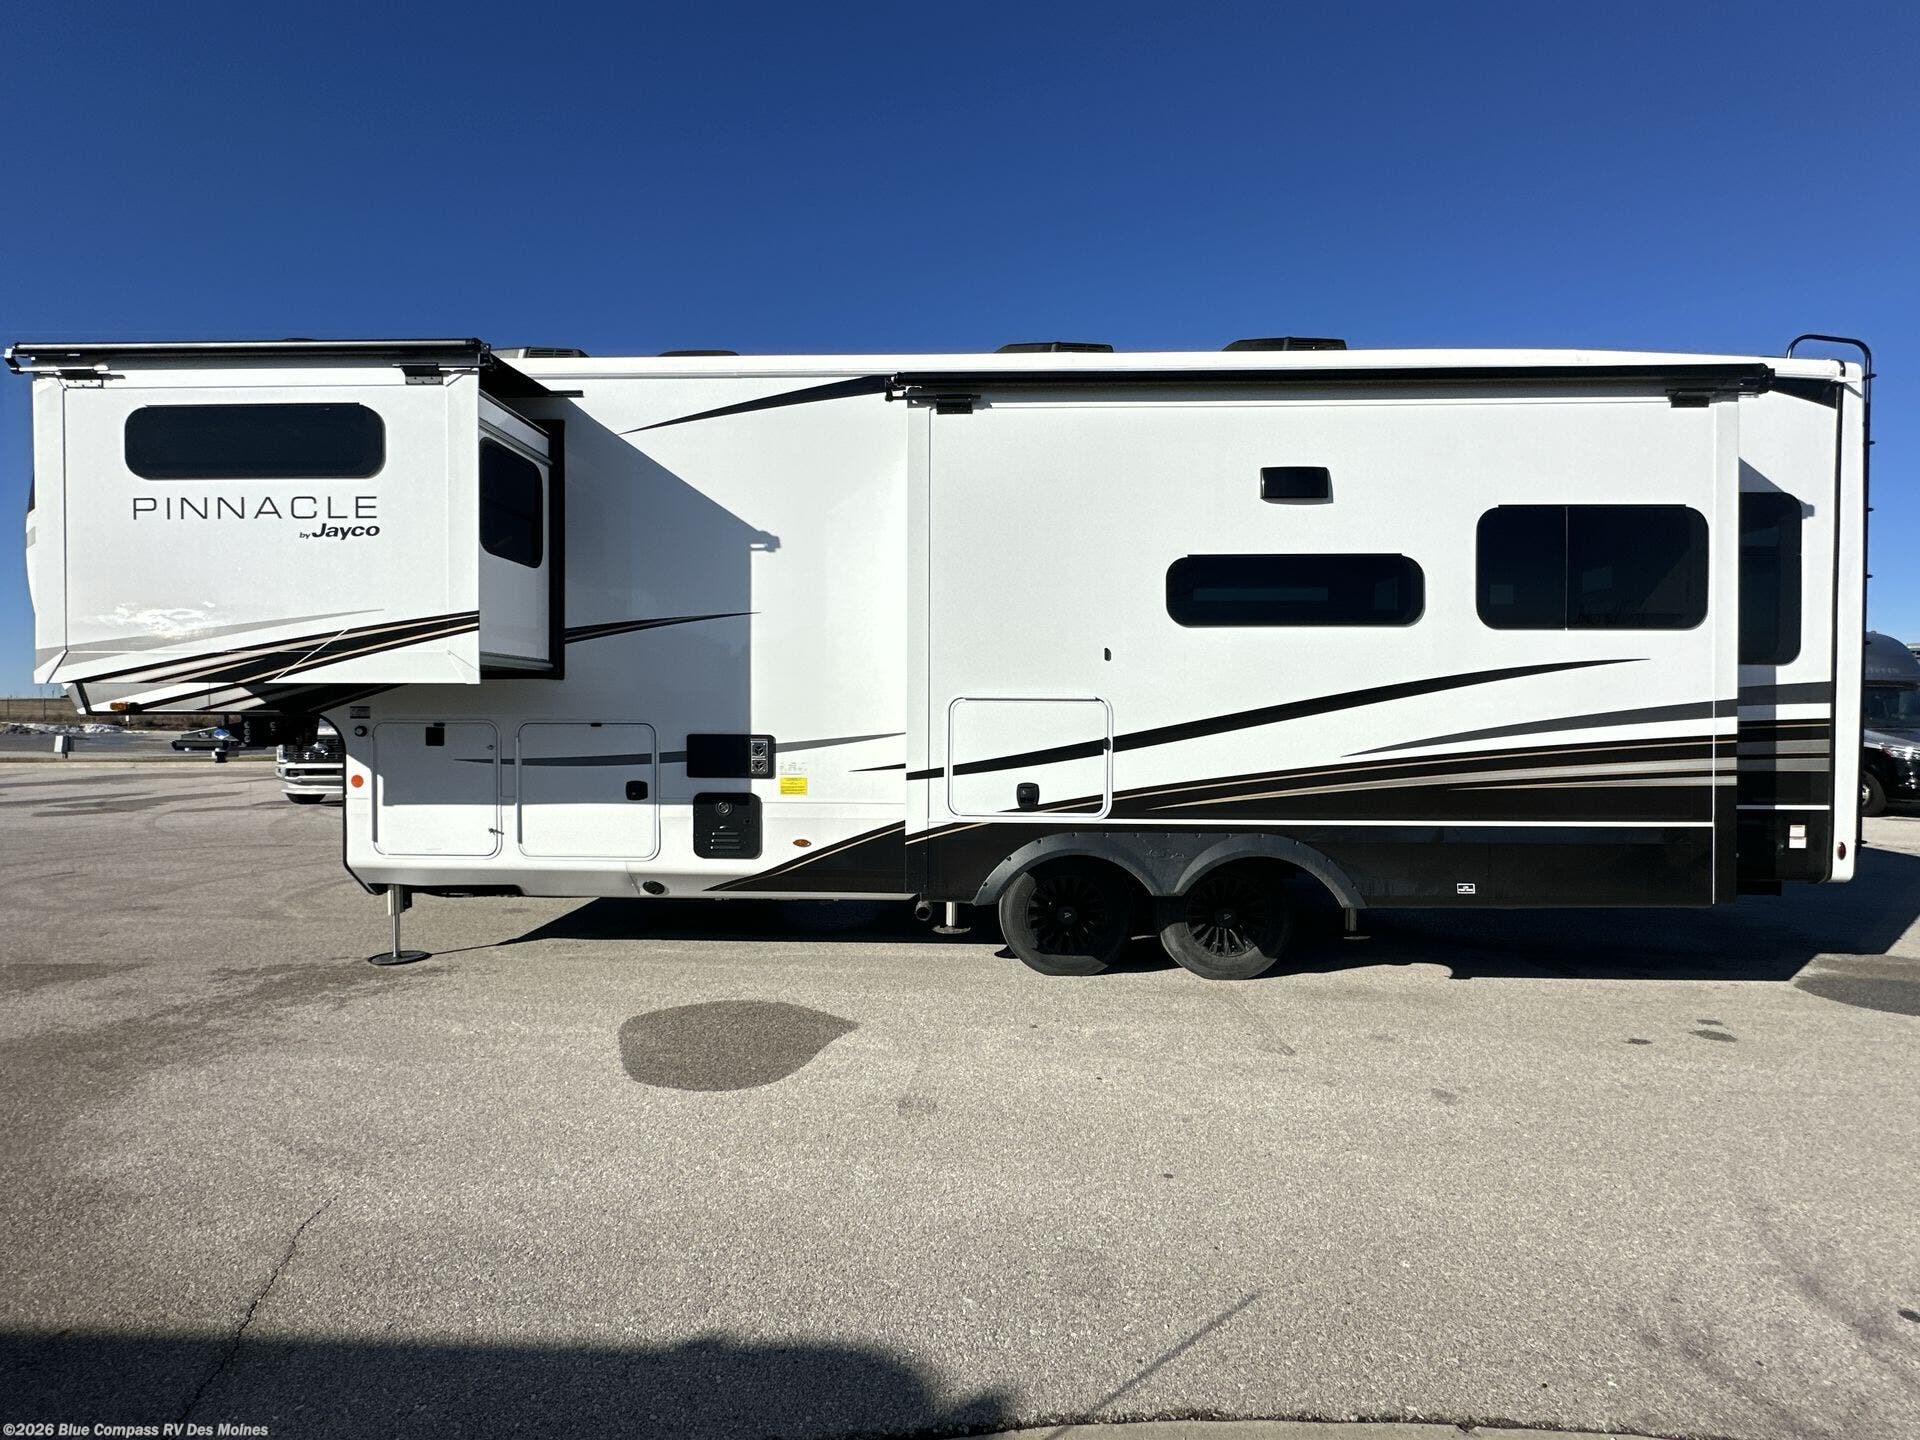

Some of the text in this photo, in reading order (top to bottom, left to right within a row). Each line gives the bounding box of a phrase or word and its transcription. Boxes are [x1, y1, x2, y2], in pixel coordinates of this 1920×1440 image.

[132, 496, 378, 520] PINNACLE
[299, 522, 381, 541] by Jayco
